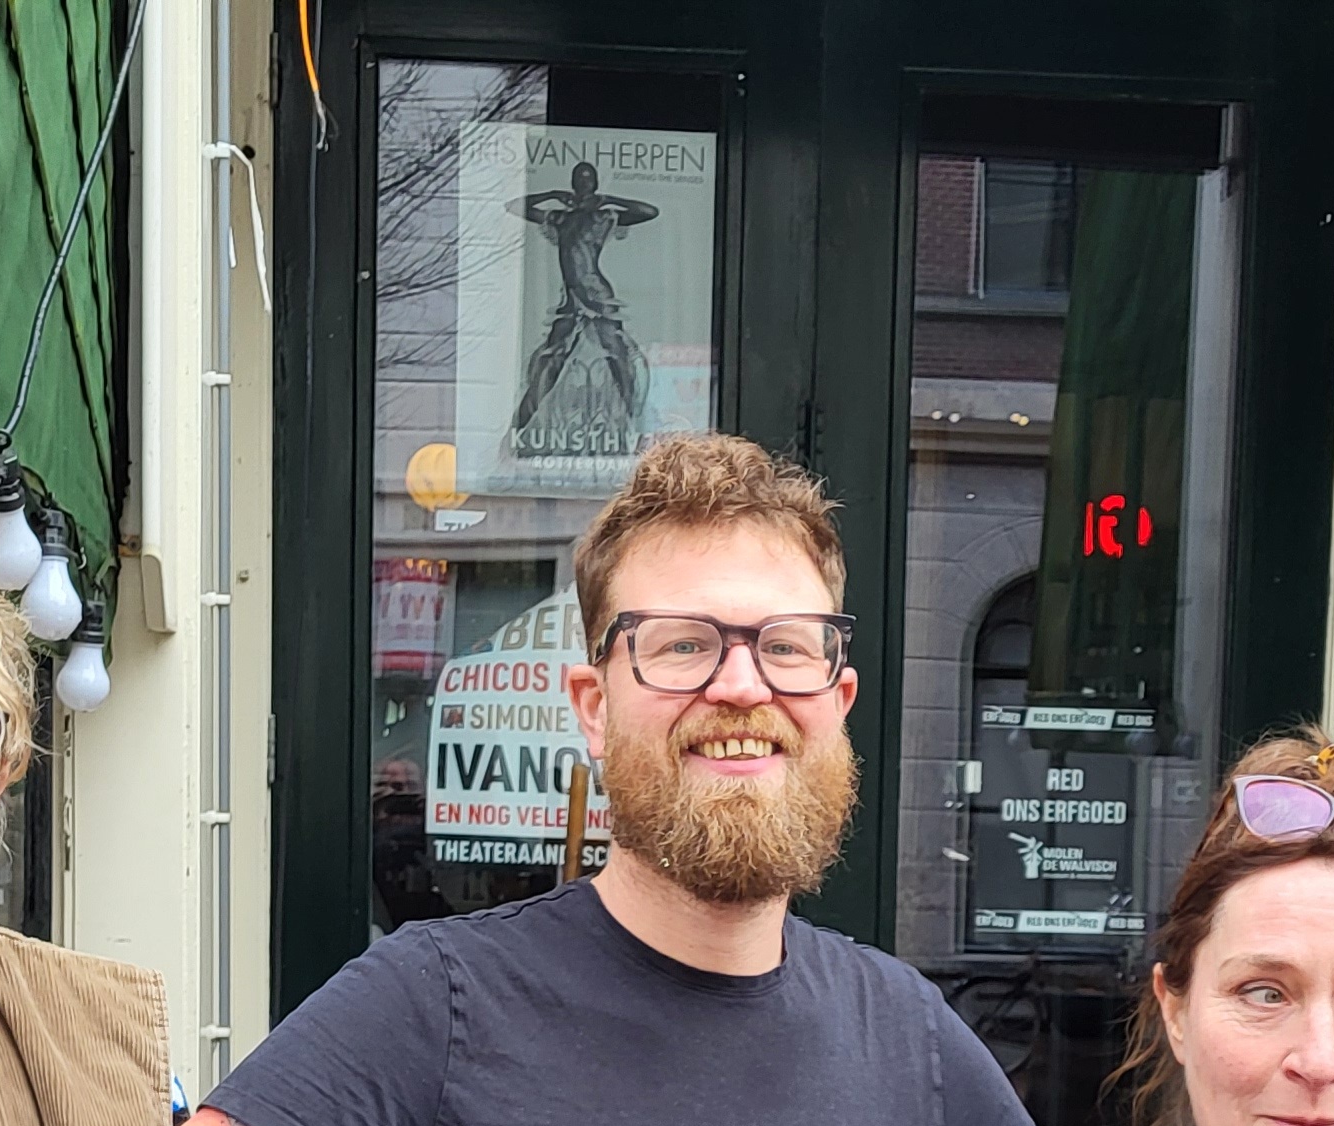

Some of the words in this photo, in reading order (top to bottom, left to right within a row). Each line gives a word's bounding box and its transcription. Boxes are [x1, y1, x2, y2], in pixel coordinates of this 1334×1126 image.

[526, 137, 586, 167] VAN
[596, 141, 705, 172] HERPEN
[444, 661, 550, 693] CHICOS
[470, 703, 570, 732] SIMONE
[1046, 768, 1084, 791] RED
[435, 803, 461, 824] EN
[468, 804, 511, 825] NOG
[518, 806, 567, 828] VELE
[1001, 799, 1040, 822] ONS
[1043, 800, 1127, 824] ERFGOED
[1043, 847, 1083, 859] MOLEN
[1042, 860, 1058, 871] DE
[1059, 860, 1117, 873] WALVISCH
